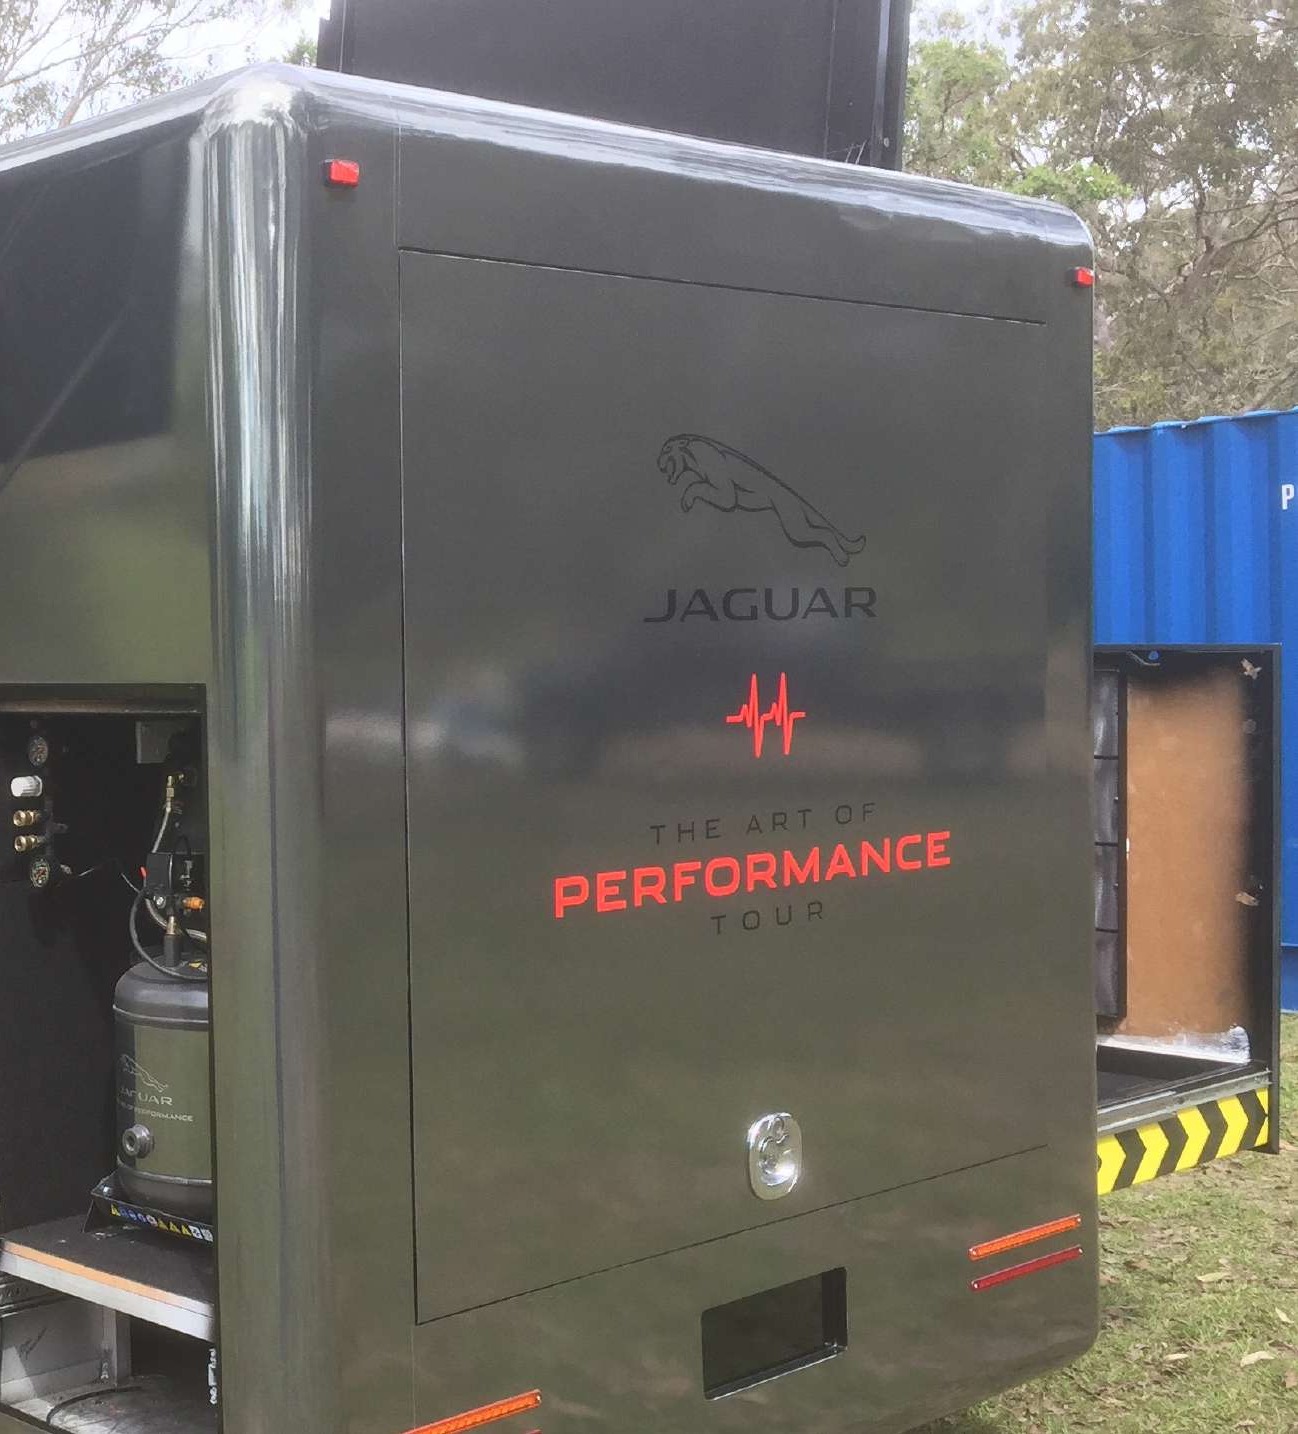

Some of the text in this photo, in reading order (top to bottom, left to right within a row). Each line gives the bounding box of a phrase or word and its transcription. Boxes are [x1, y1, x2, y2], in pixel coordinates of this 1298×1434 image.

[1282, 484, 1295, 510] P
[643, 587, 878, 623] JAGUAR
[650, 803, 878, 846] THE ART OF
[554, 831, 951, 919] PERFORMANCE
[710, 901, 824, 936] TOUR
